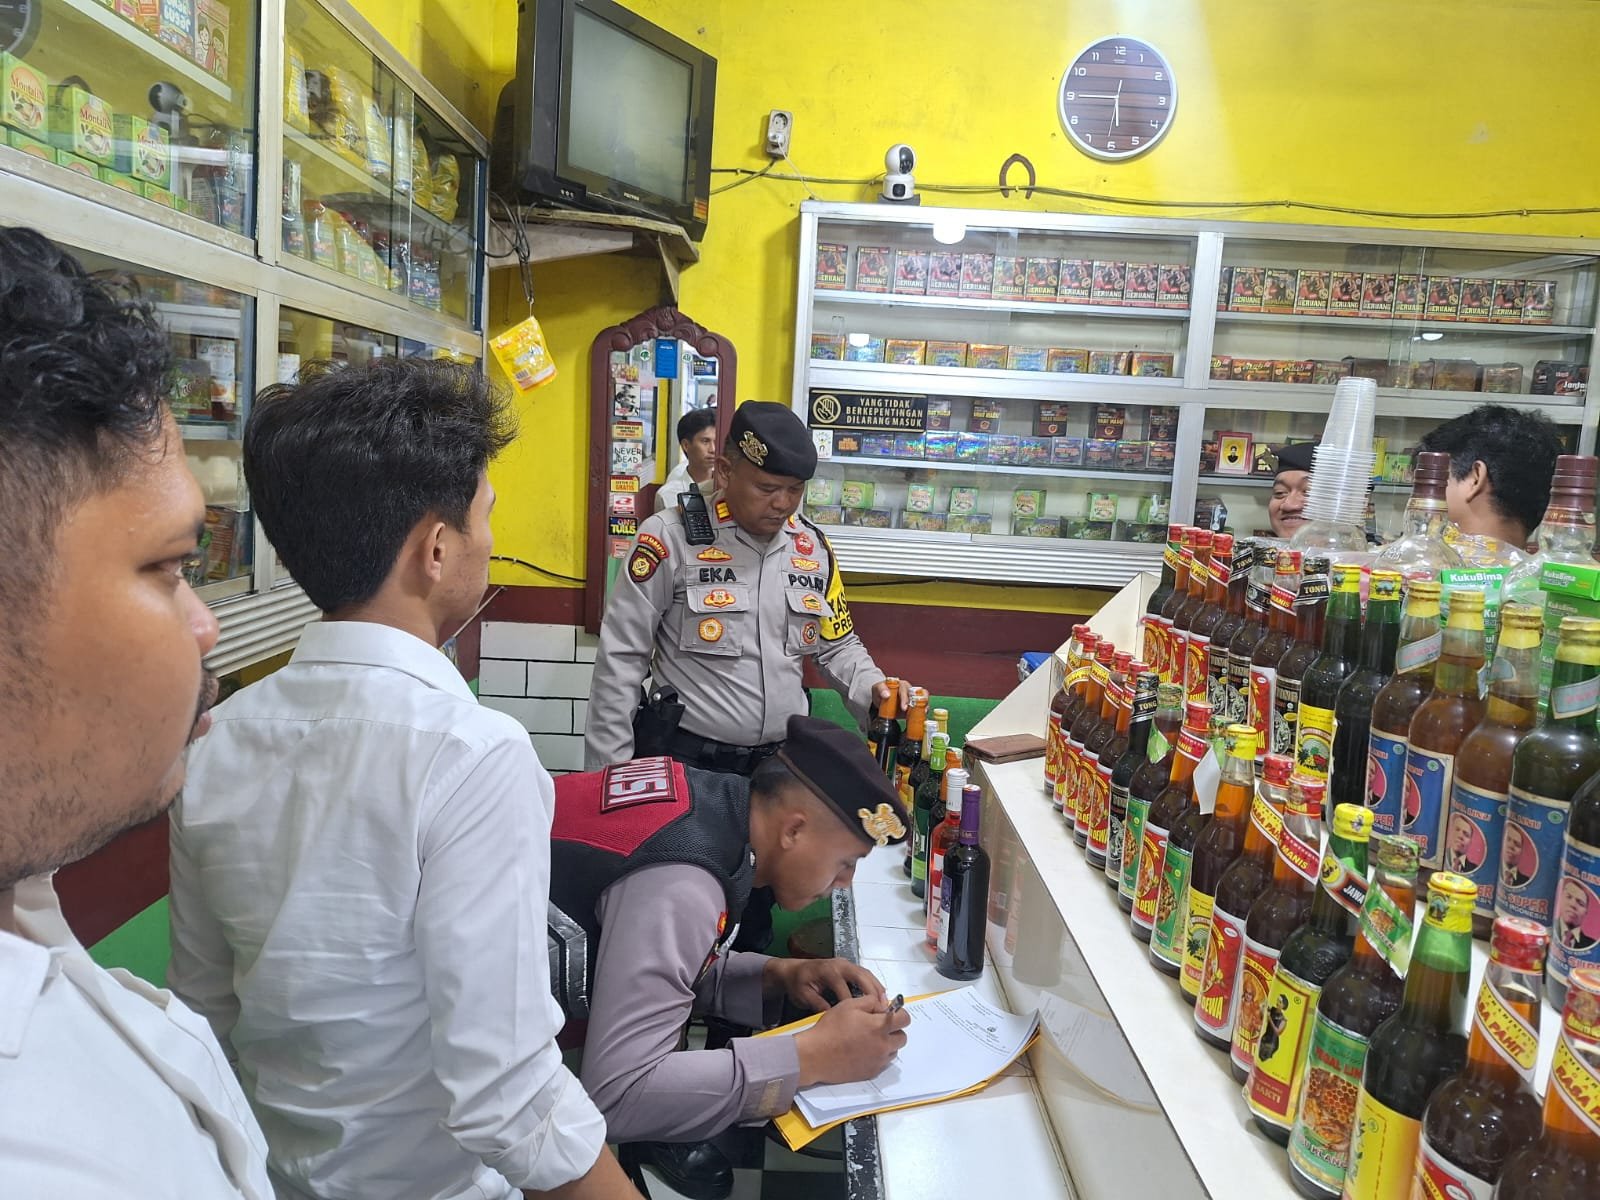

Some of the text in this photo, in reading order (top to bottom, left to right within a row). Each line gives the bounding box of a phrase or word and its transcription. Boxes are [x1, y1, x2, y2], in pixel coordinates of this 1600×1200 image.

[1114, 46, 1127, 55] 12
[1092, 52, 1099, 61] 11
[1139, 53, 1144, 63] 1
[1074, 67, 1087, 76] 10
[1154, 71, 1163, 81] 2
[1066, 91, 1075, 100] 9
[1158, 96, 1166, 105] 3
[1070, 115, 1079, 125] 8
[1150, 119, 1159, 129] 4
[1085, 133, 1092, 143] 7
[1131, 136, 1140, 145] 5
[1107, 141, 1116, 151] 6
[860, 398, 911, 409] YANG TIDAK
[846, 406, 923, 418] BERKEPENTINGAN
[846, 415, 922, 427] DILARANG MASUK
[615, 447, 642, 456] NEVER
[1236, 556, 1253, 569] TONG
[699, 567, 737, 583] EKA
[1450, 572, 1503, 582] KukuBima
[1543, 569, 1576, 582] KukuBima
[1303, 583, 1327, 595] TONG
[1547, 602, 1578, 613] KukuBima
[1139, 700, 1158, 711] TONG
[1281, 844, 1308, 870] MANIS
[1343, 883, 1367, 904] JAWA
[1507, 894, 1549, 915] SUPER
[1509, 904, 1548, 920] INDONESIA
[1489, 1021, 1526, 1057] PAHIT
[1556, 1065, 1590, 1108] RASA
